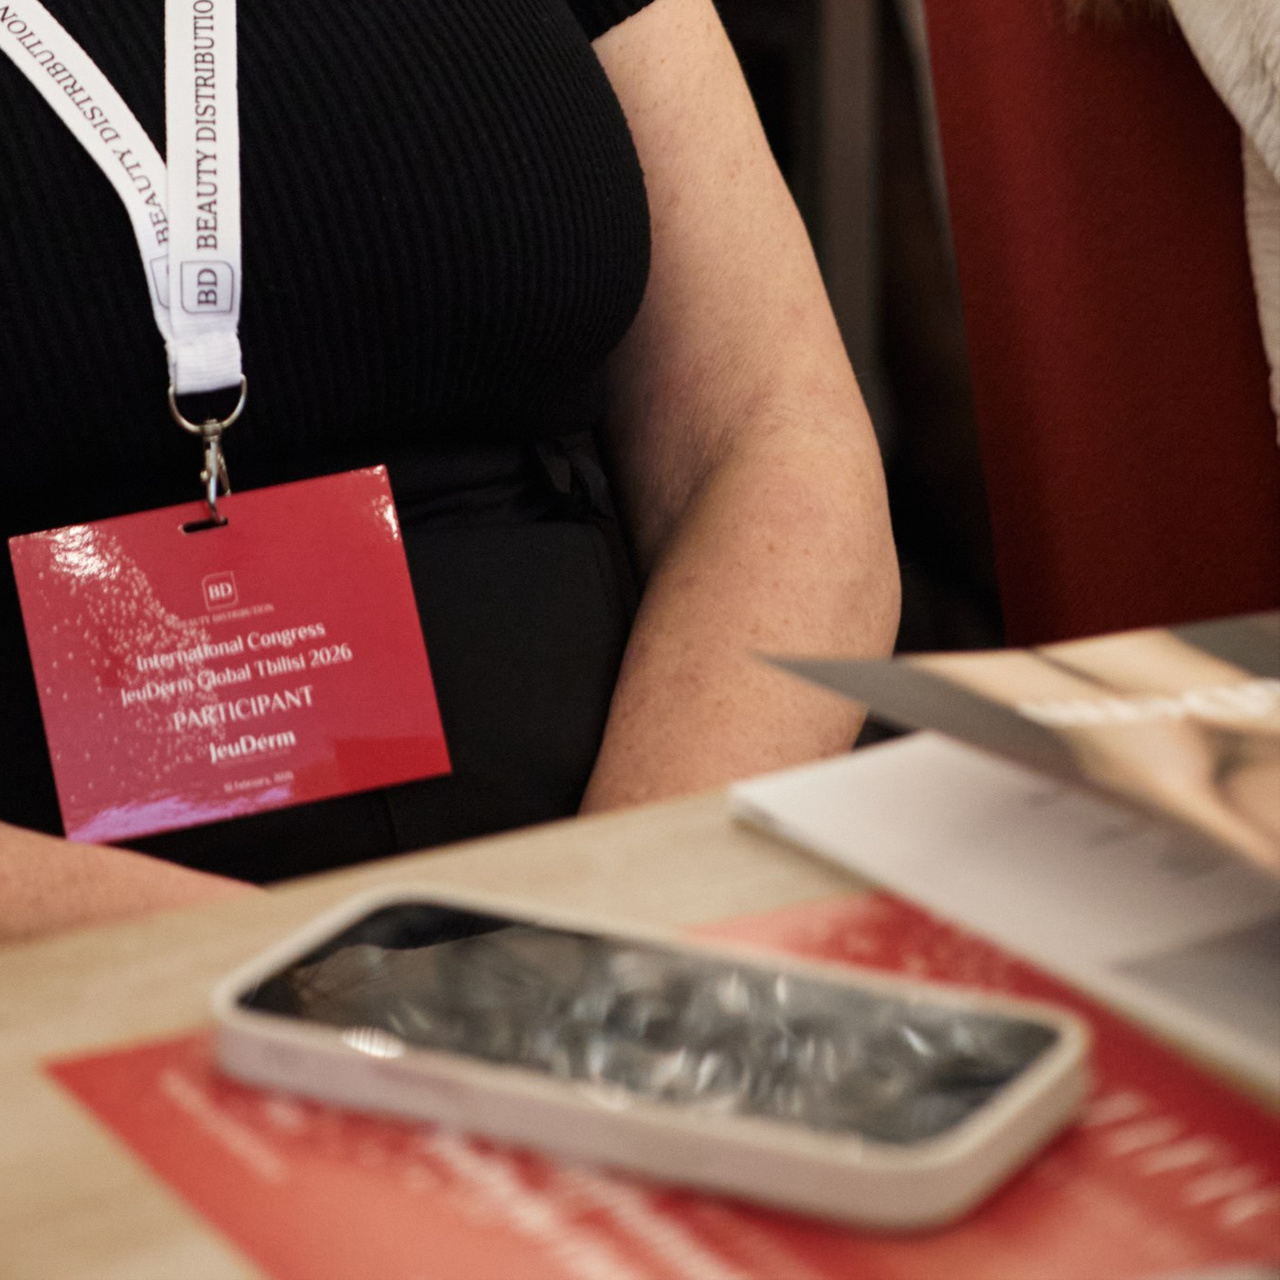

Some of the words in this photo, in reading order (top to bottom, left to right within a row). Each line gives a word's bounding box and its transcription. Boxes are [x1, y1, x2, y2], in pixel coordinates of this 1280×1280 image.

[196, 150, 217, 250] BEAUTY
[197, 268, 217, 306] BD
[208, 581, 233, 600] BD
[136, 635, 244, 672] International
[247, 623, 326, 650] Congress
[121, 679, 194, 707] JeuDerm
[198, 665, 251, 690] Global
[254, 654, 305, 677] Tbilisi
[310, 643, 353, 667] 2026
[173, 684, 313, 731] PARTICIPANT
[209, 730, 296, 764] JeuDerm
